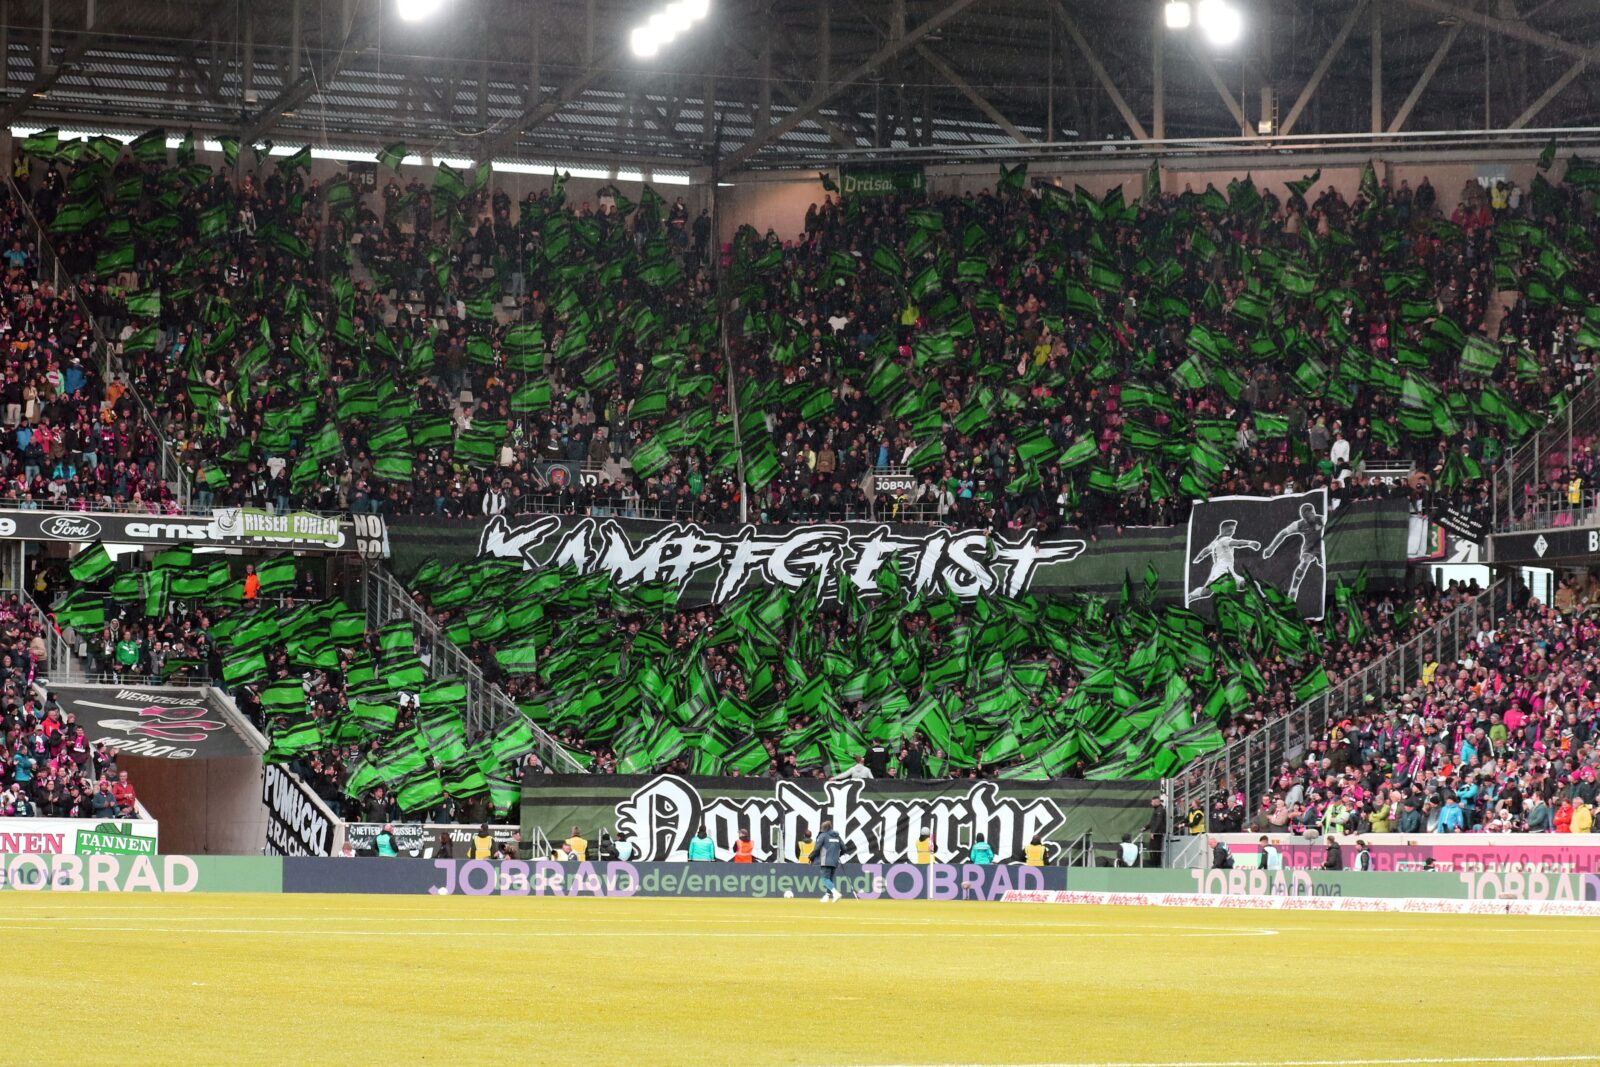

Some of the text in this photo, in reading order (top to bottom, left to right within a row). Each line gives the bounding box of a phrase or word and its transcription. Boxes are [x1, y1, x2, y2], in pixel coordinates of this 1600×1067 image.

[845, 176, 894, 193] Dreisa
[51, 517, 90, 536] Ford
[244, 512, 339, 536] RIESER FOHLEN
[479, 515, 1086, 606] KAMPFGEIST
[115, 689, 204, 706] WERKZEUGE
[264, 764, 329, 857] PUMUCKL
[615, 774, 1066, 865] Nordkurve
[79, 833, 153, 852] TANNEN
[0, 854, 199, 892] OBRAD
[430, 858, 640, 897] JOBRAD
[859, 863, 1044, 901] JOBRAD
